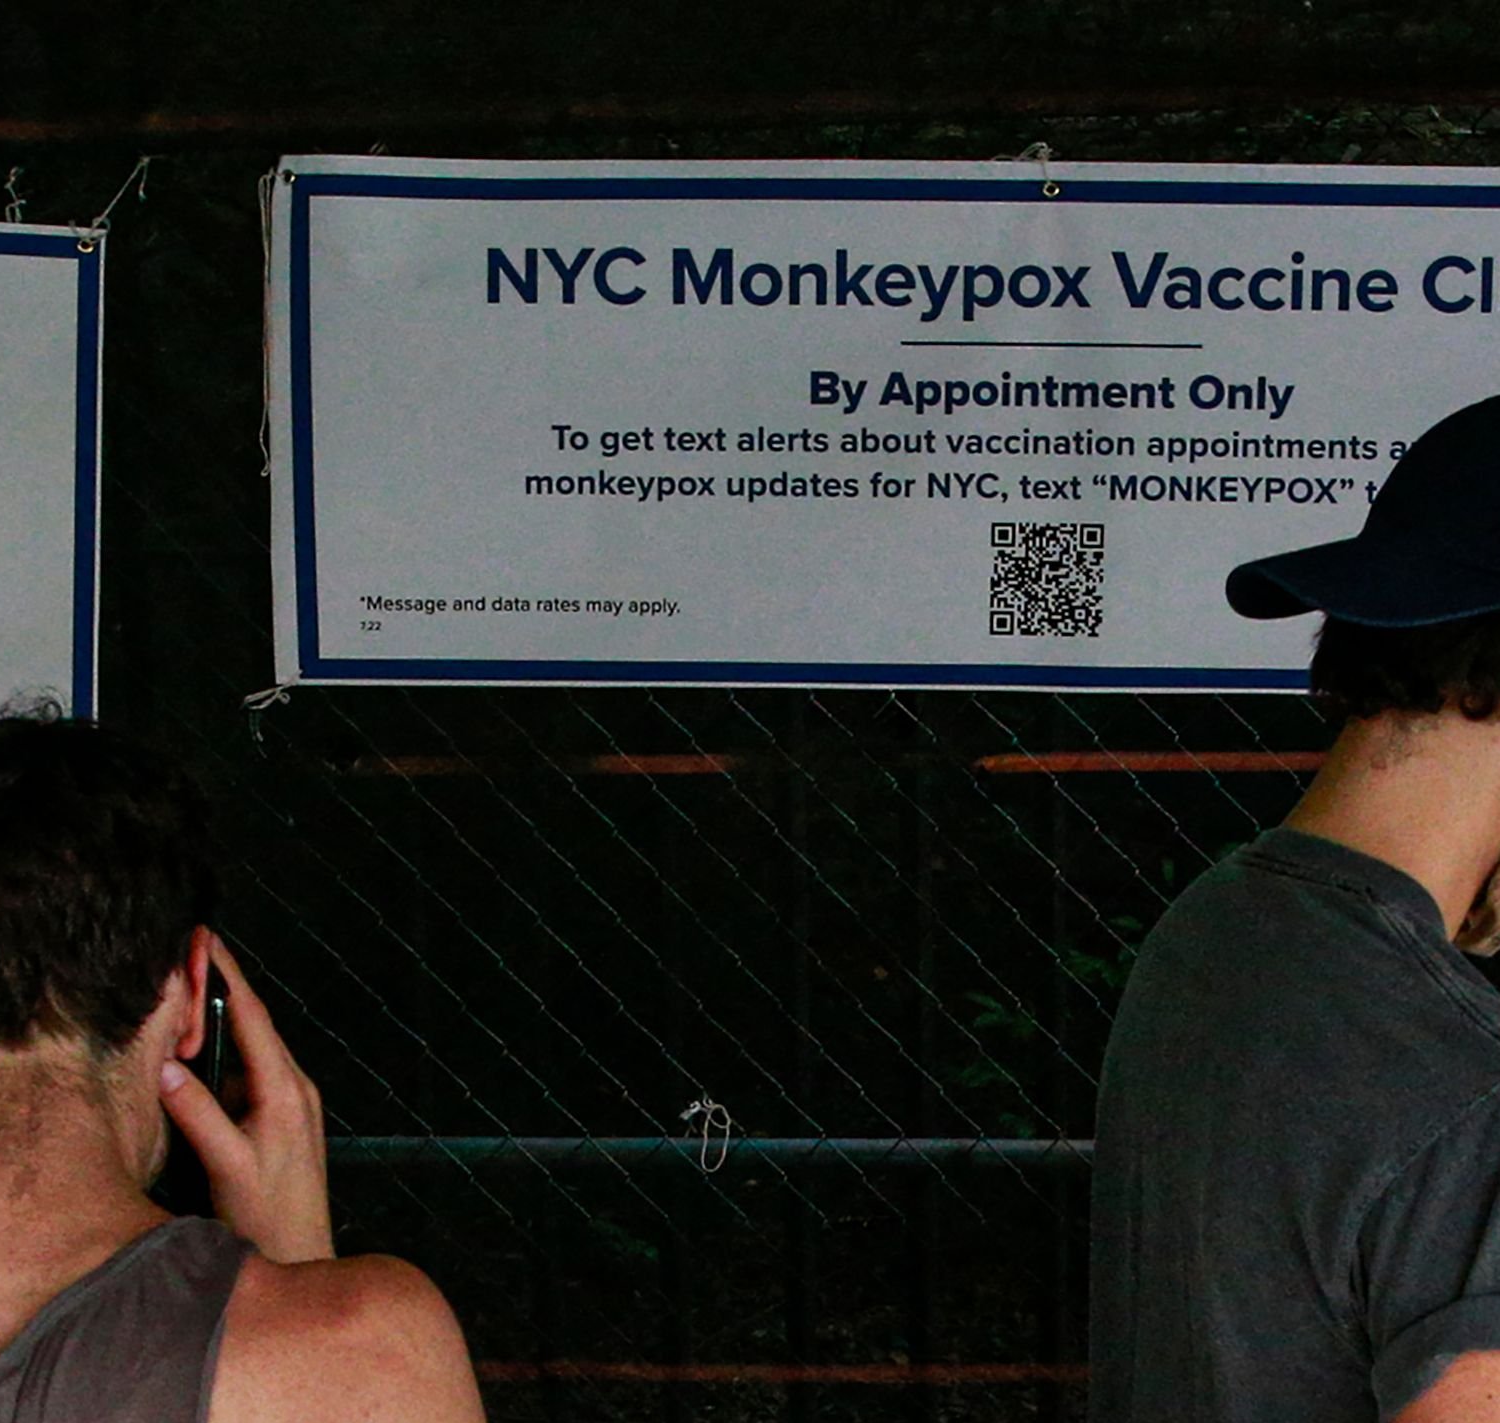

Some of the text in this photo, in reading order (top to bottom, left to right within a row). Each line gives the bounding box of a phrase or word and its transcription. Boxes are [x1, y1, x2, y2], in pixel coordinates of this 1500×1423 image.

[486, 246, 647, 306] NYC
[672, 247, 1091, 323] Monkeypox
[1111, 250, 1399, 313] Vaccine
[810, 370, 1295, 420] By Appointment Only
[551, 424, 589, 451] To
[600, 427, 654, 458] get
[663, 427, 727, 452] text
[737, 426, 829, 453] alerts
[840, 427, 936, 454] about
[945, 427, 1135, 456] vaccination
[1146, 431, 1378, 464] appointments
[525, 469, 715, 502] monkeypox
[726, 471, 859, 503] updates
[869, 471, 916, 498] for
[927, 472, 1008, 503] NYC,
[1018, 475, 1082, 501] text
[452, 596, 486, 612] and
[491, 596, 531, 612] data
[536, 598, 581, 613] rates
[585, 600, 624, 617] may
[628, 598, 681, 617] apply.
